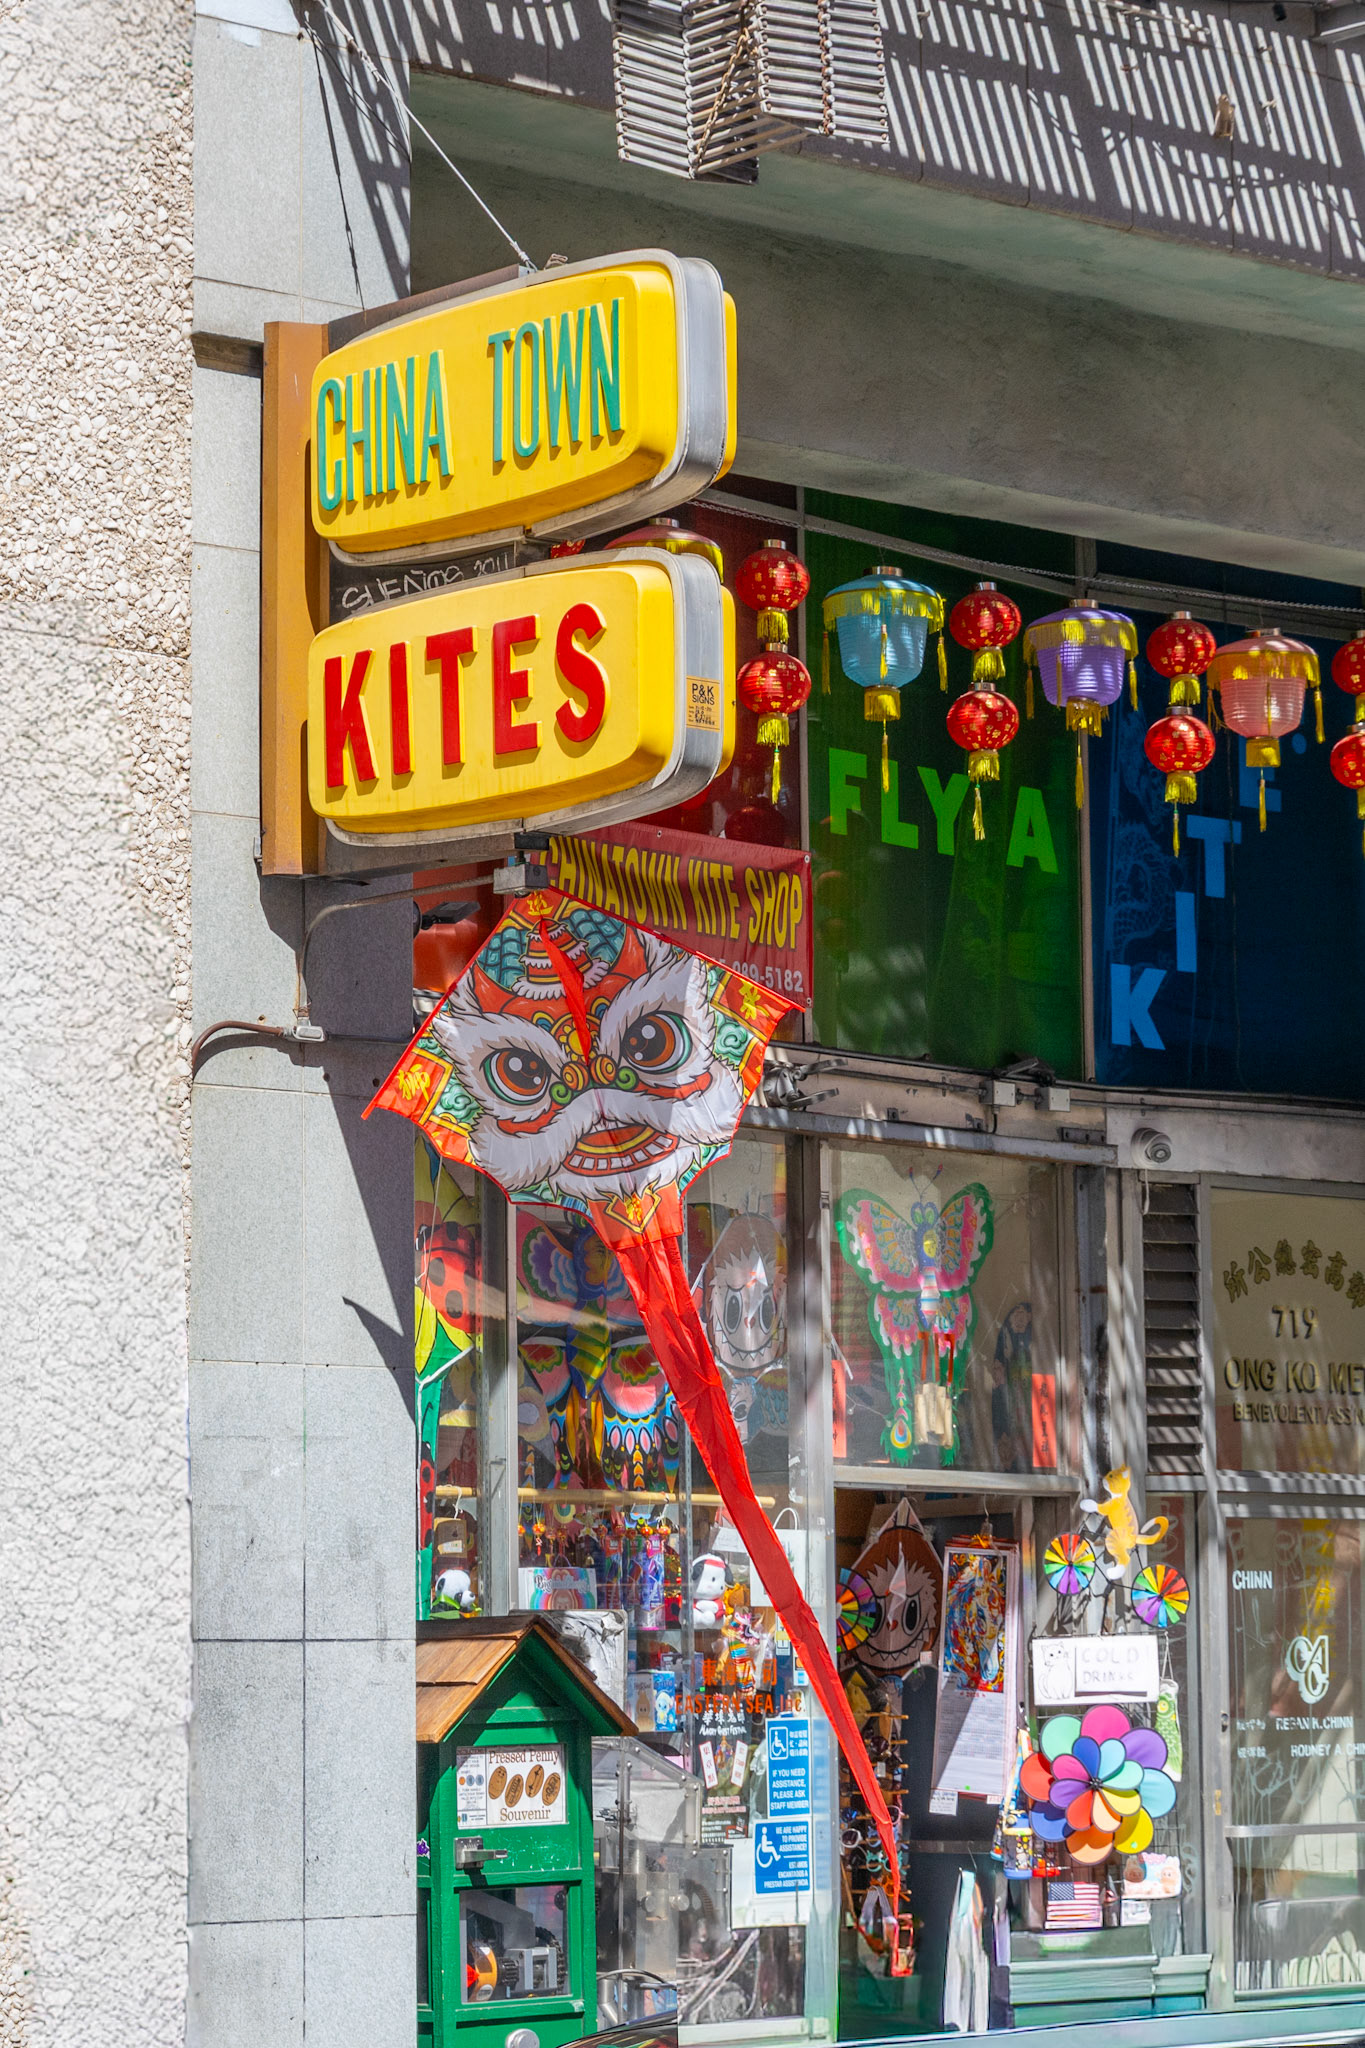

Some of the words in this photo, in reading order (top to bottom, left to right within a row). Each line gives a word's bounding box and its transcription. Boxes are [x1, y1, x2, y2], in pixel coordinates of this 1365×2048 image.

[317, 348, 455, 512] CHINA
[487, 297, 626, 464] TOWN
[323, 602, 607, 788] KITES
[691, 682, 715, 698] P&K
[691, 694, 716, 706] SIGNS
[828, 747, 970, 856] FLY
[1005, 786, 1060, 874] A
[688, 859, 742, 940] KITE
[744, 866, 804, 950] SHOP
[1271, 1304, 1319, 1340] 719
[1224, 1356, 1277, 1391] ONG
[1285, 1359, 1320, 1394] KO
[1232, 1402, 1323, 1424] BENEVOLENT
[1231, 1570, 1273, 1591] CHINN
[1080, 1647, 1140, 1664] COLD
[674, 1694, 741, 1715] EASTERN
[1325, 1715, 1354, 1731] CHINN
[488, 1750, 527, 1765] Pressed
[528, 1749, 560, 1766] Penny
[772, 1769, 778, 1777] IF
[778, 1769, 789, 1777] YOU
[790, 1768, 806, 1777] NEED
[773, 1790, 794, 1799] PLEASE
[794, 1790, 806, 1798] ASK
[499, 1806, 551, 1822] Souvenir
[770, 1801, 786, 1810] STAFF
